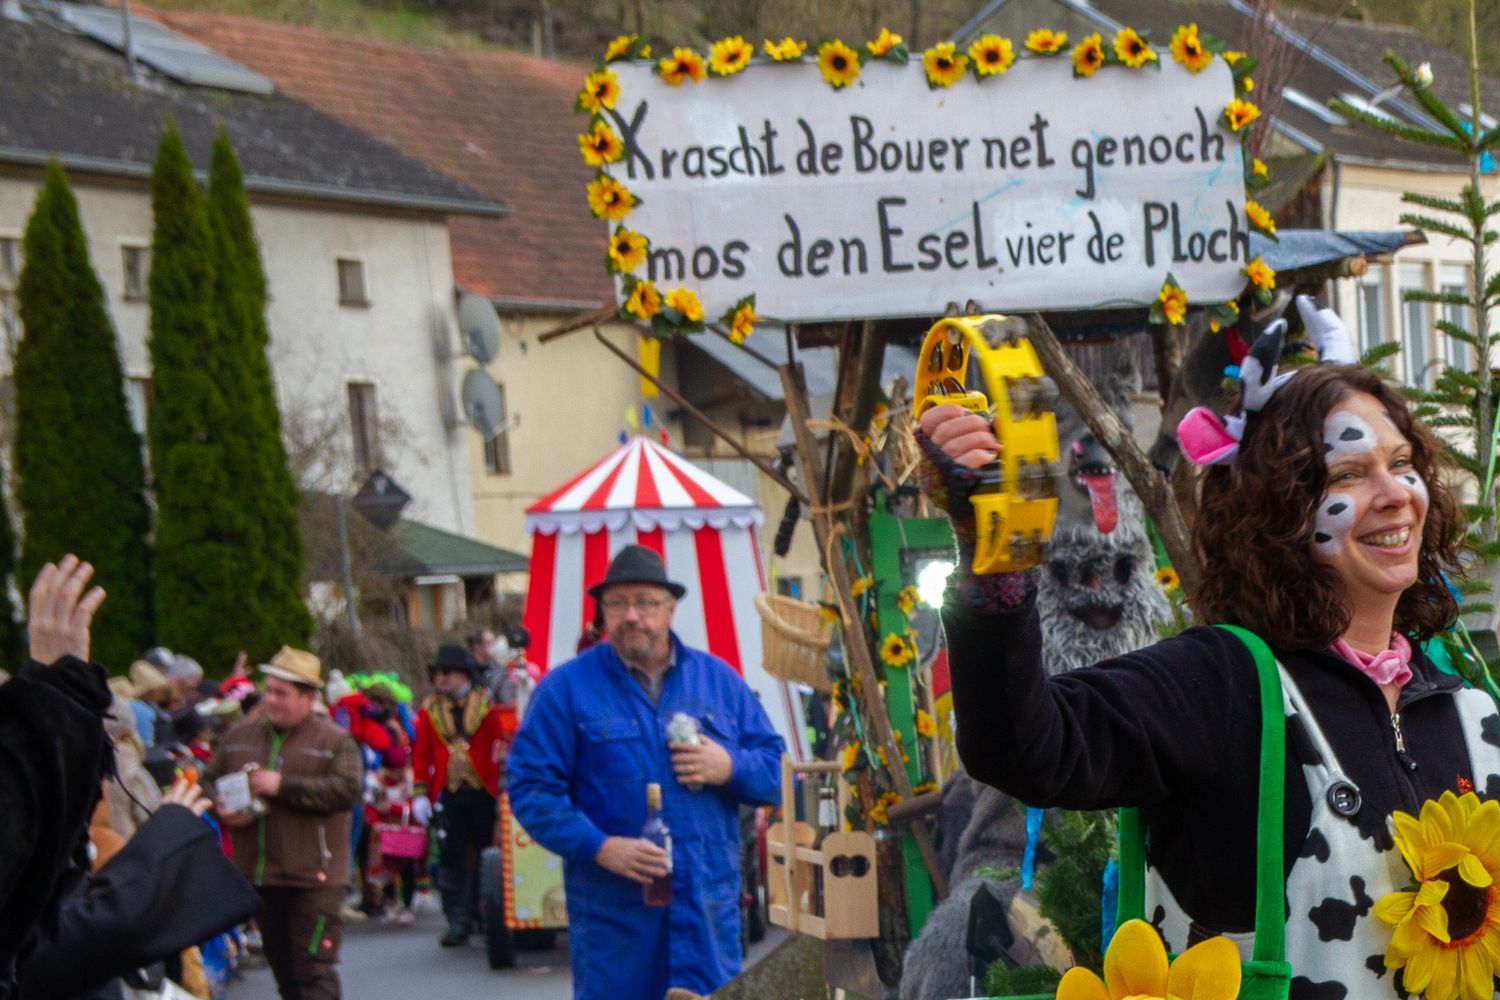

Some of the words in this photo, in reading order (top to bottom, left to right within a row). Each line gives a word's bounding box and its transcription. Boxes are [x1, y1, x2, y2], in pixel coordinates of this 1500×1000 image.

[796, 117, 843, 177] de
[850, 114, 970, 175] Bouer
[981, 112, 1055, 170] net
[1070, 107, 1225, 200] genoch
[646, 237, 748, 283] mos
[777, 213, 868, 279] den
[1004, 213, 1075, 269] vier
[1086, 210, 1125, 264] de
